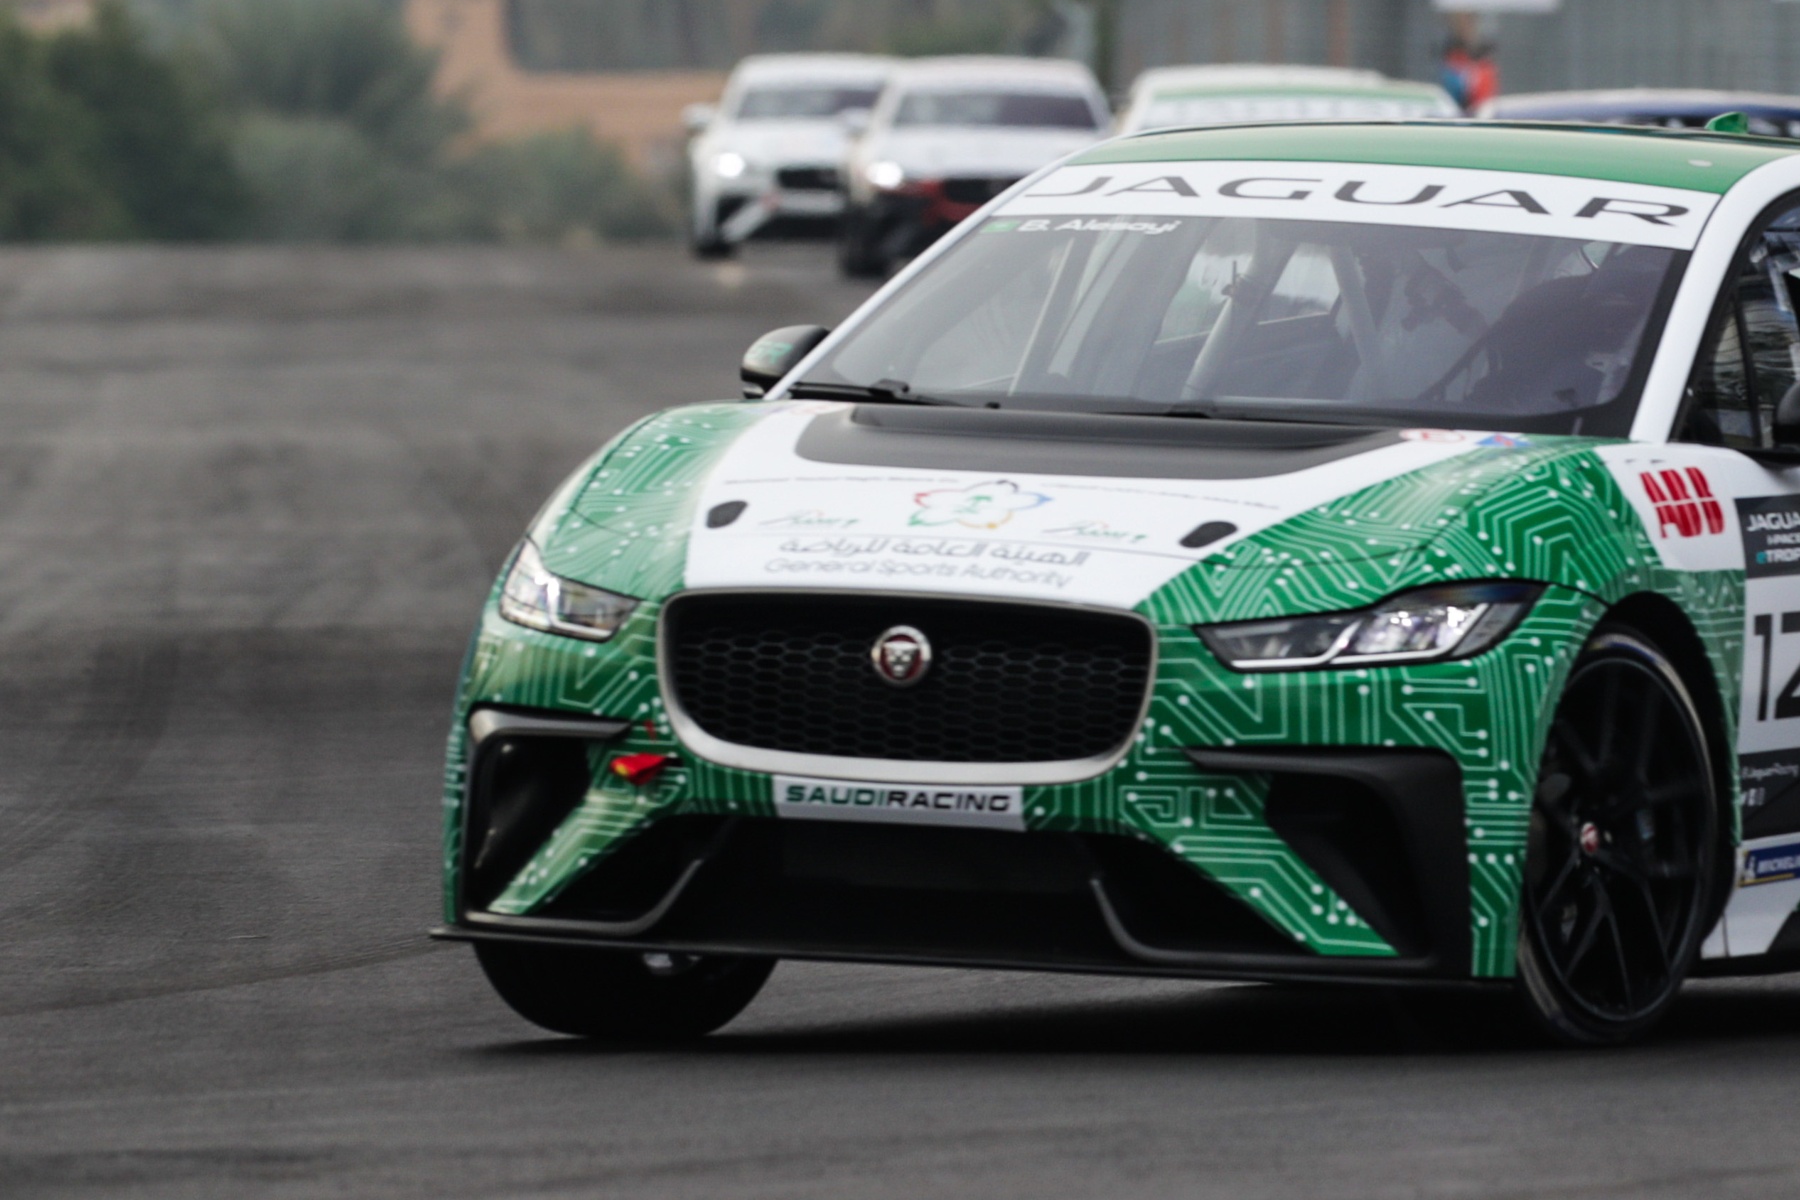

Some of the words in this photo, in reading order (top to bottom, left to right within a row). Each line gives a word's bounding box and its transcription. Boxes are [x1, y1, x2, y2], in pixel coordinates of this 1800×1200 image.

[1024, 176, 1692, 227] JAGUAR
[1640, 466, 1725, 539] ABB
[763, 557, 877, 575] General
[878, 559, 960, 579] Sports
[959, 562, 1076, 589] Authority
[786, 784, 1011, 812] SAUDIRACING
